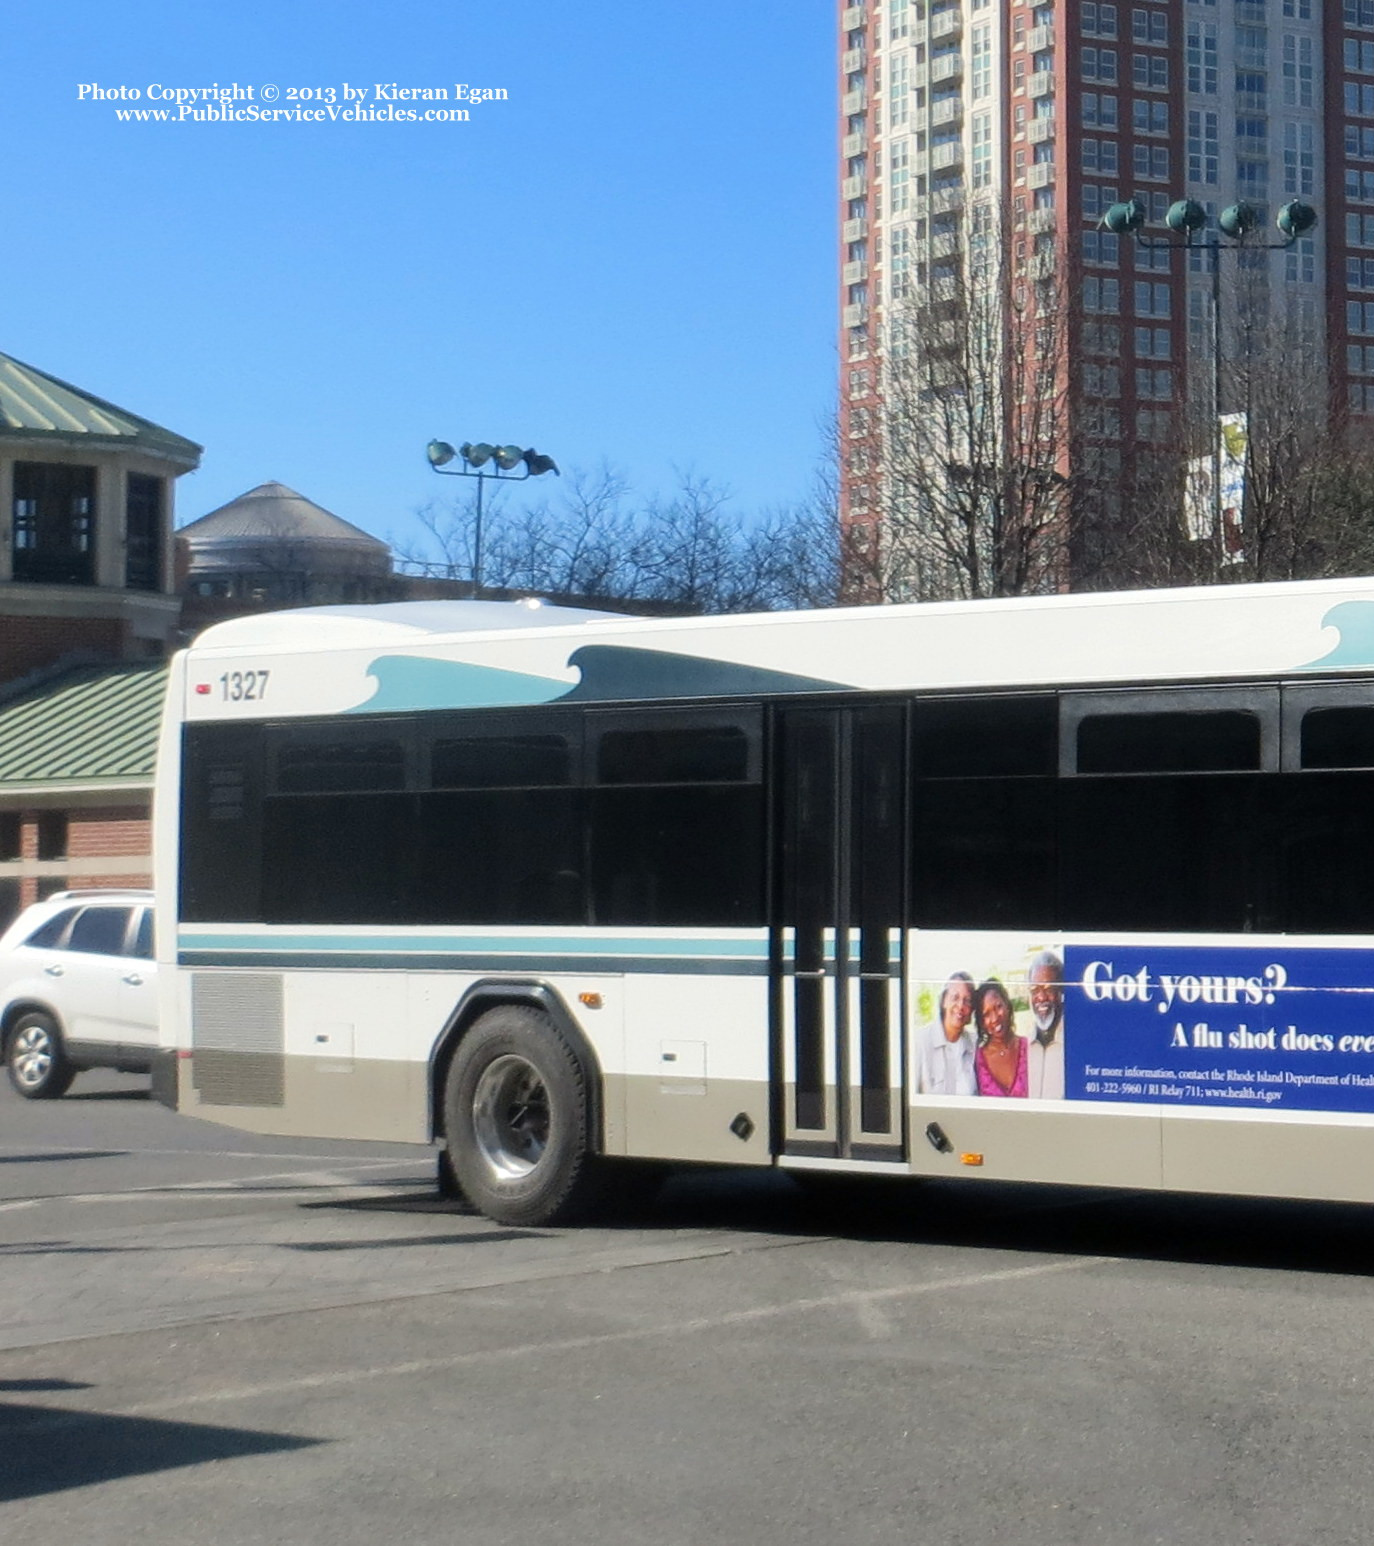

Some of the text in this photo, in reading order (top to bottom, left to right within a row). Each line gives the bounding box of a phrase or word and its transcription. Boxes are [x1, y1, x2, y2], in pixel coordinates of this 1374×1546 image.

[220, 669, 270, 702] 1327
[1083, 961, 1287, 1014] Got yours?
[1170, 1022, 1189, 1048] A
[1193, 1022, 1223, 1048] flu
[1228, 1023, 1277, 1049] shot
[1281, 1025, 1334, 1052] does
[1085, 1064, 1100, 1076] For
[1101, 1066, 1123, 1077] more
[1124, 1065, 1177, 1079] information,
[1178, 1069, 1209, 1080] contact
[1210, 1068, 1225, 1081] the
[1226, 1069, 1255, 1082] Rhode
[1257, 1070, 1283, 1083] Island
[1285, 1071, 1338, 1087] Department
[1340, 1073, 1351, 1085] of
[1148, 1084, 1159, 1096] RI
[1161, 1084, 1184, 1099] Relay
[1205, 1086, 1282, 1103] www.health.ri.gov
